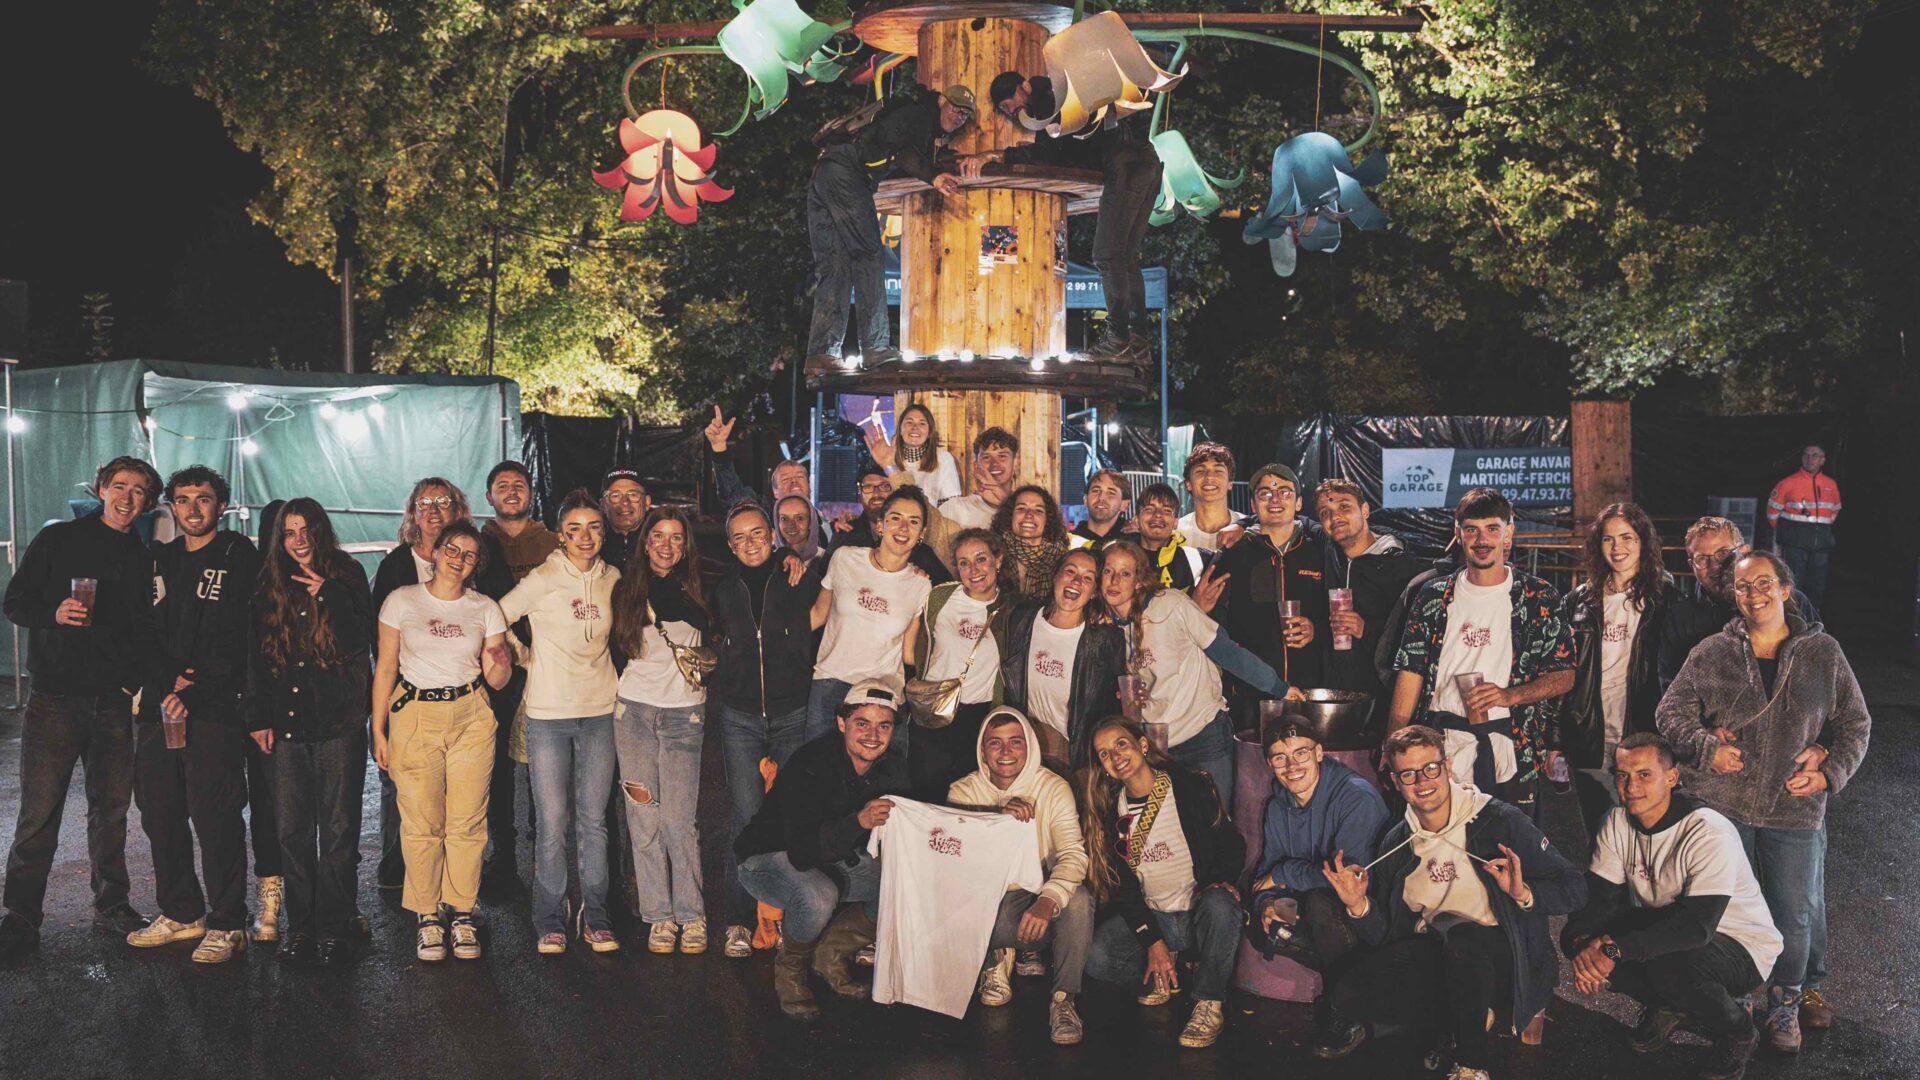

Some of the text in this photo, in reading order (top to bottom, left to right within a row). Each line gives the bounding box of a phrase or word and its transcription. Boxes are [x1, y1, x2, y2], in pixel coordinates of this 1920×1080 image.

[1476, 456, 1571, 470] GARAGE NAVAR
[1405, 473, 1430, 483] TOP
[1460, 470, 1571, 486] MARTIGNÉ-FERCH
[1389, 483, 1444, 492] GARAGE
